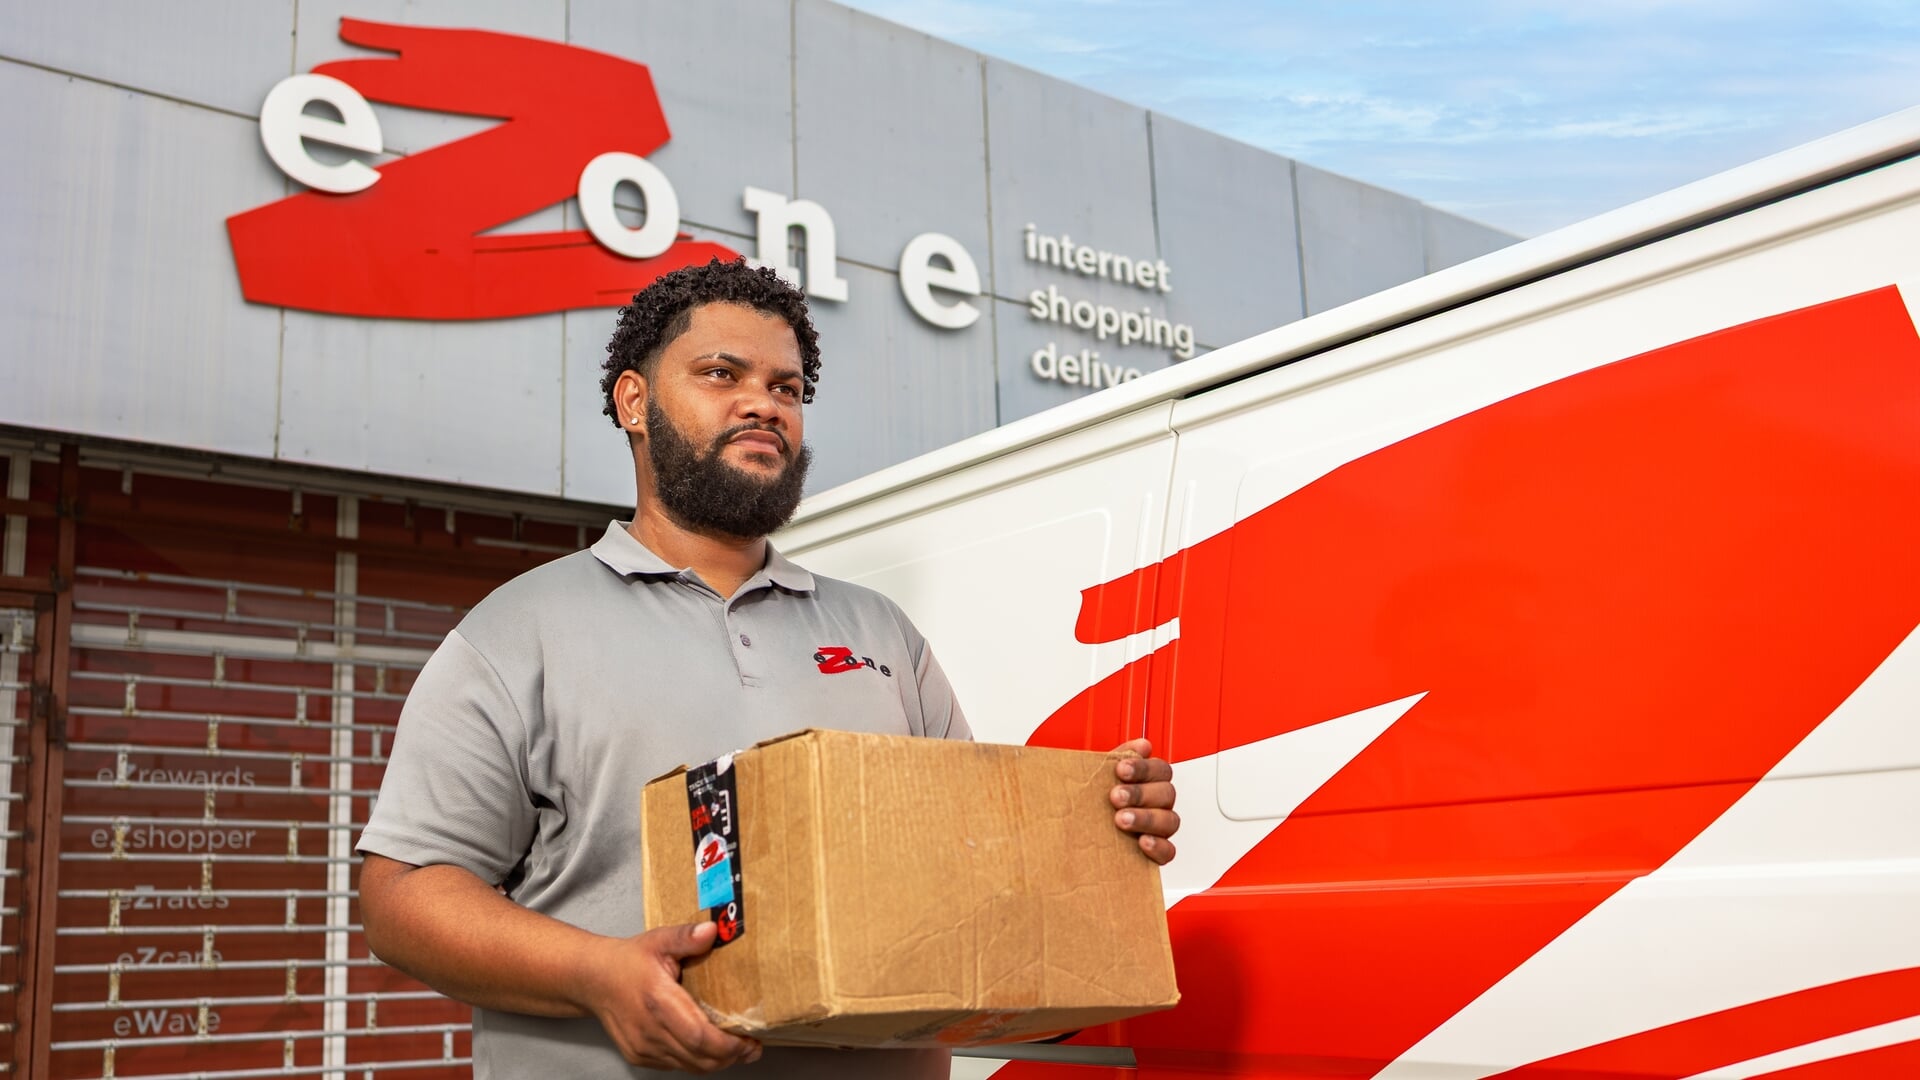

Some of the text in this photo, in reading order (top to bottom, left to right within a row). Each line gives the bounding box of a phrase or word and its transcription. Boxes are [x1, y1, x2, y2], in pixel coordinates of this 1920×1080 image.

[1025, 223, 1173, 293] internet
[1029, 285, 1195, 359] shopping
[1031, 341, 1144, 389] deliv
[813, 647, 892, 677] eZone
[113, 1009, 221, 1037] eWave
